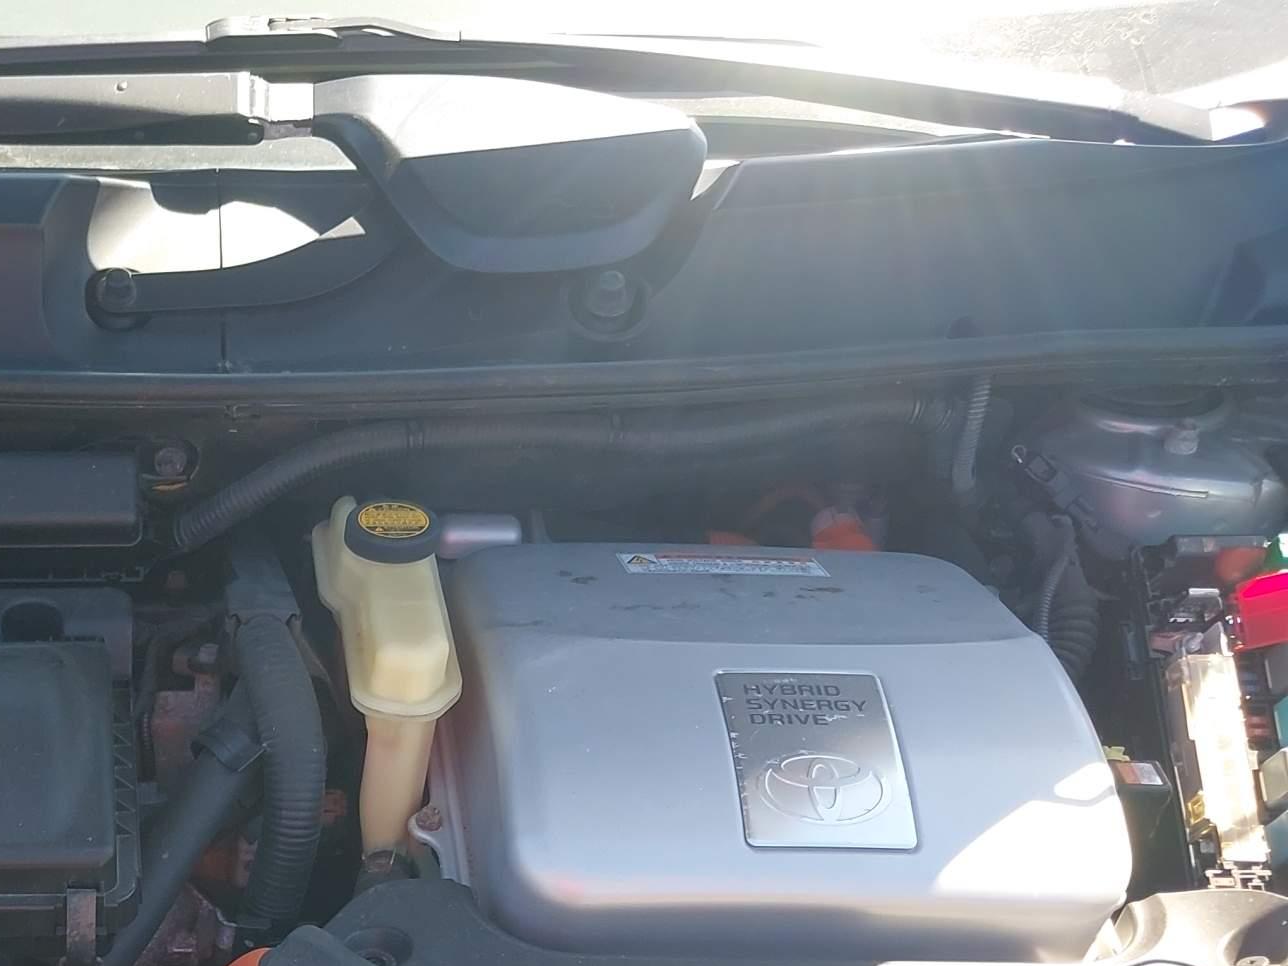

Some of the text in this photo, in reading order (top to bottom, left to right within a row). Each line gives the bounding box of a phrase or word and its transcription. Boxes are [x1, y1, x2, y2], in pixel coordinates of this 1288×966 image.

[743, 684, 841, 697] HYBRID
[746, 699, 868, 712] SYNERGY
[749, 713, 829, 725] DRIVE
